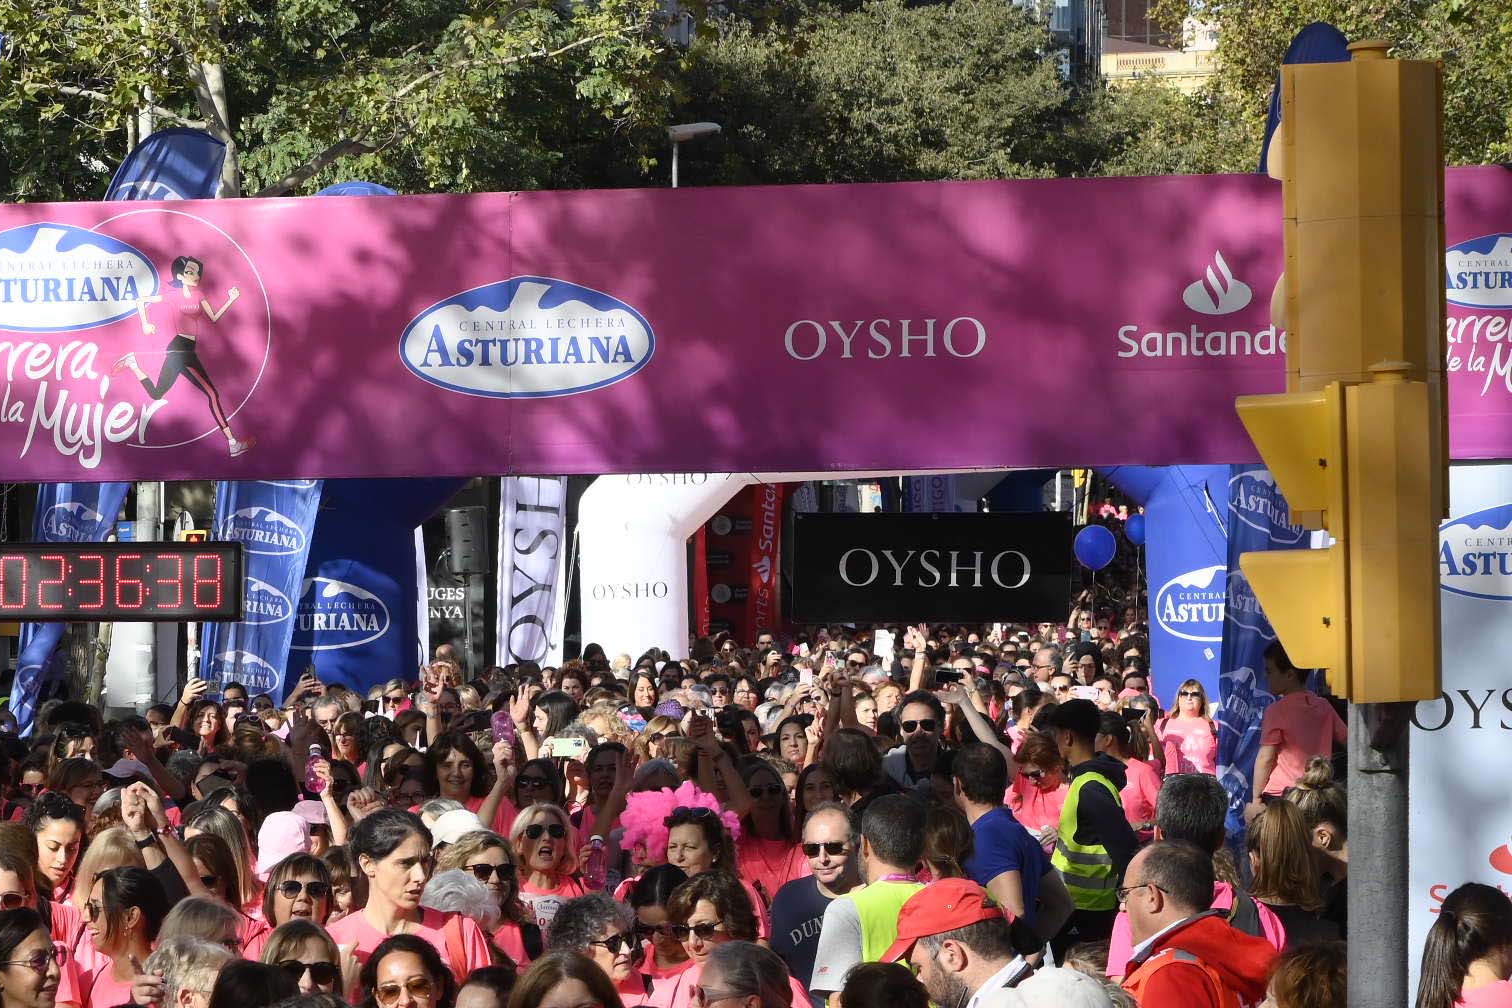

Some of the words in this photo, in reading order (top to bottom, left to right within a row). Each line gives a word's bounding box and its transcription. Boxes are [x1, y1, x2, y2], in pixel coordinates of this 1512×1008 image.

[61, 258, 135, 271] LECHERA
[459, 319, 538, 333] CENTRAL
[545, 317, 626, 331] LECHERA
[784, 316, 987, 360] OYSHO
[420, 324, 636, 368] ASTURIANA
[1468, 344, 1486, 371] la
[1, 383, 25, 424] la
[19, 376, 169, 469] Mujer
[0, 555, 222, 610] 02:36:38
[838, 548, 1031, 590] OYSHO
[592, 582, 668, 601] OYSHO
[429, 605, 464, 619] NYA
